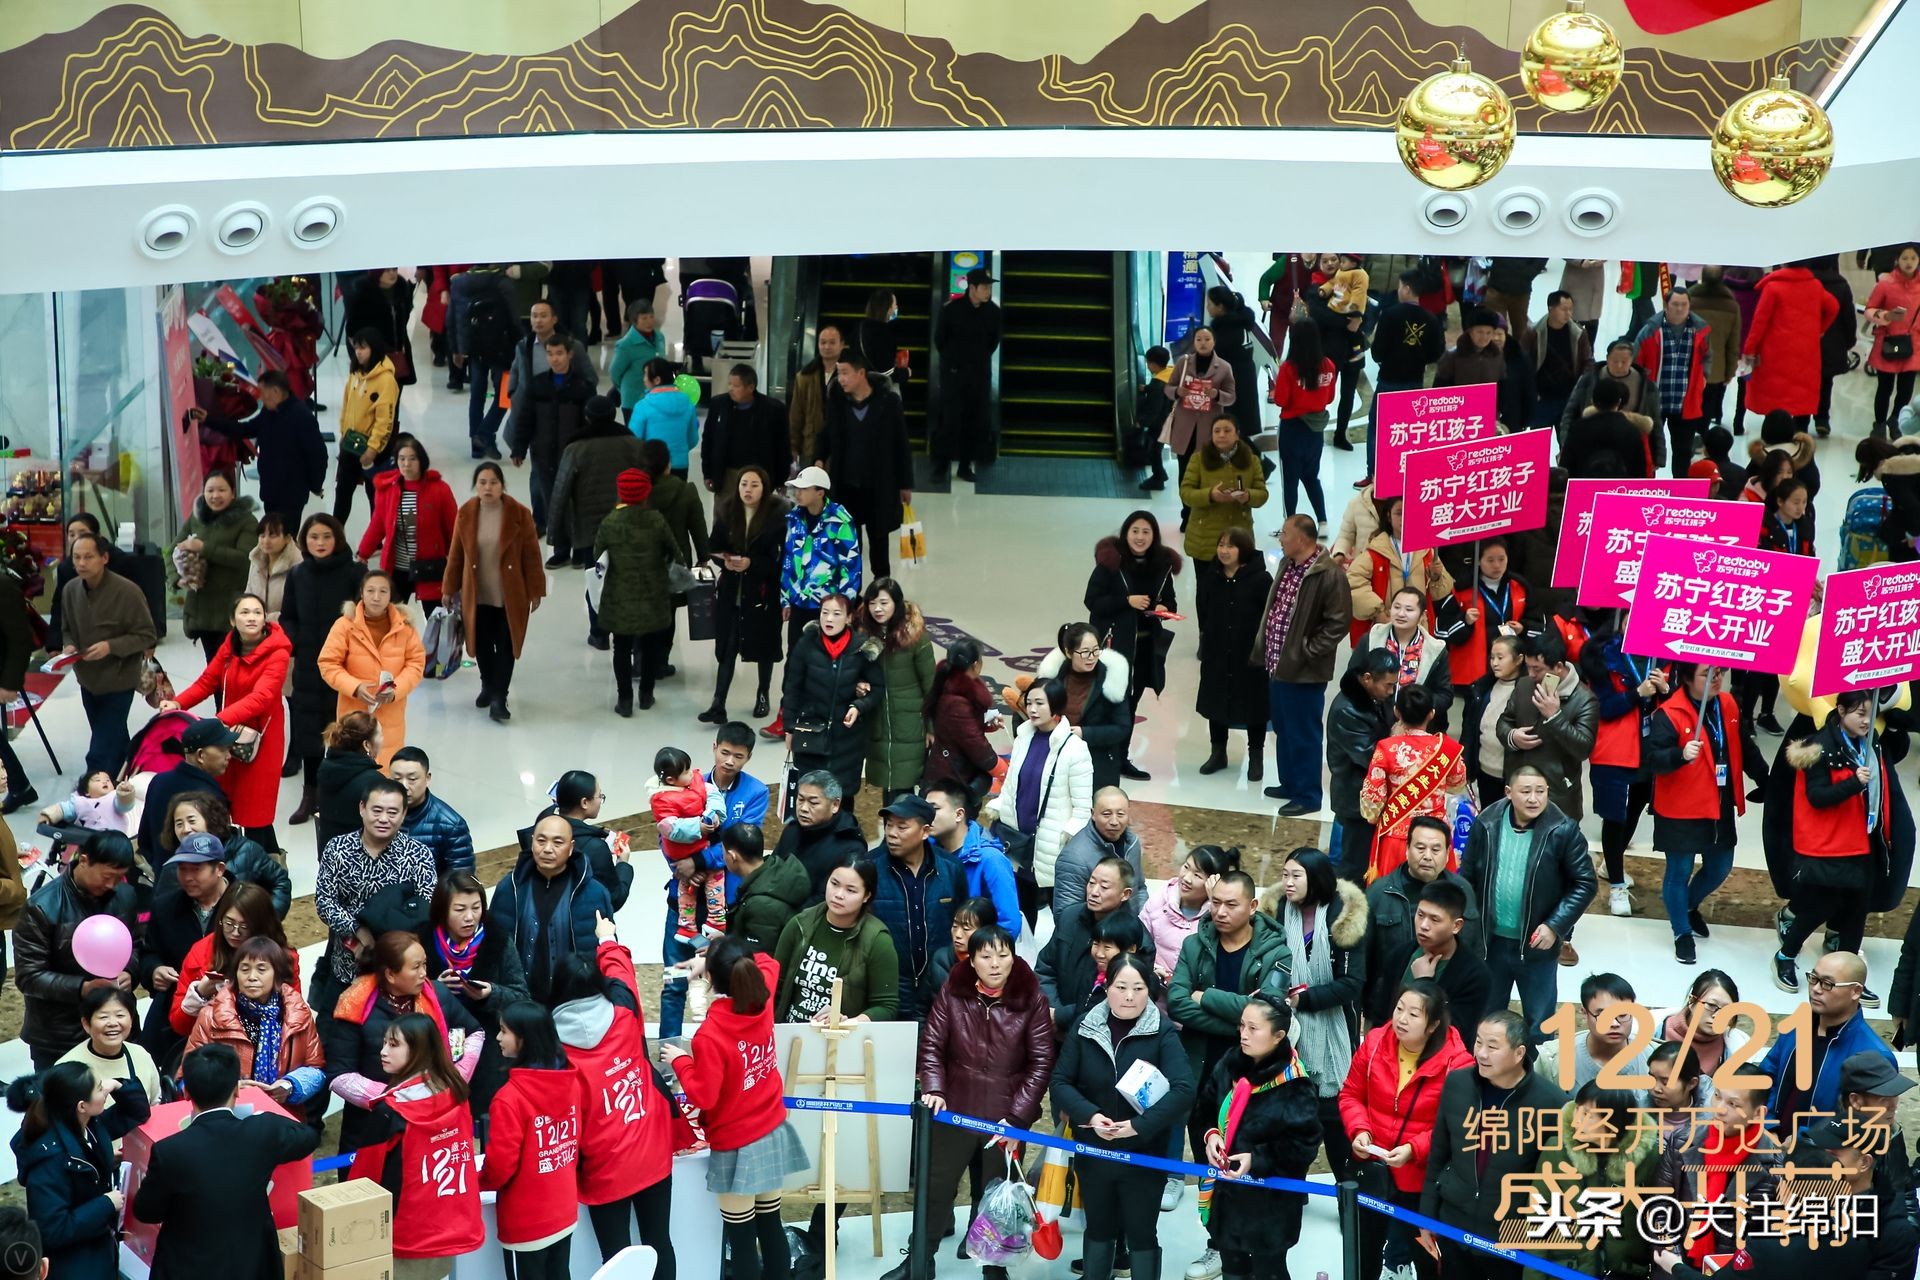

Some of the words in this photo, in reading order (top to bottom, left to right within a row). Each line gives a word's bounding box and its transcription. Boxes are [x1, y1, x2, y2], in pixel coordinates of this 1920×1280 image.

[1429, 395, 1465, 406] redbaby
[1390, 415, 1484, 447] 苏宁红孩子
[1468, 445, 1512, 459] redbaby
[1419, 461, 1536, 503] 苏宁红孩子
[1430, 490, 1524, 526] 盛大开业
[1665, 508, 1717, 522] redbaby
[1717, 555, 1771, 574] redbaby
[1653, 571, 1793, 616] 苏宁红孩子
[1661, 607, 1775, 646] 盛大开业
[535, 1116, 577, 1149] 12/21
